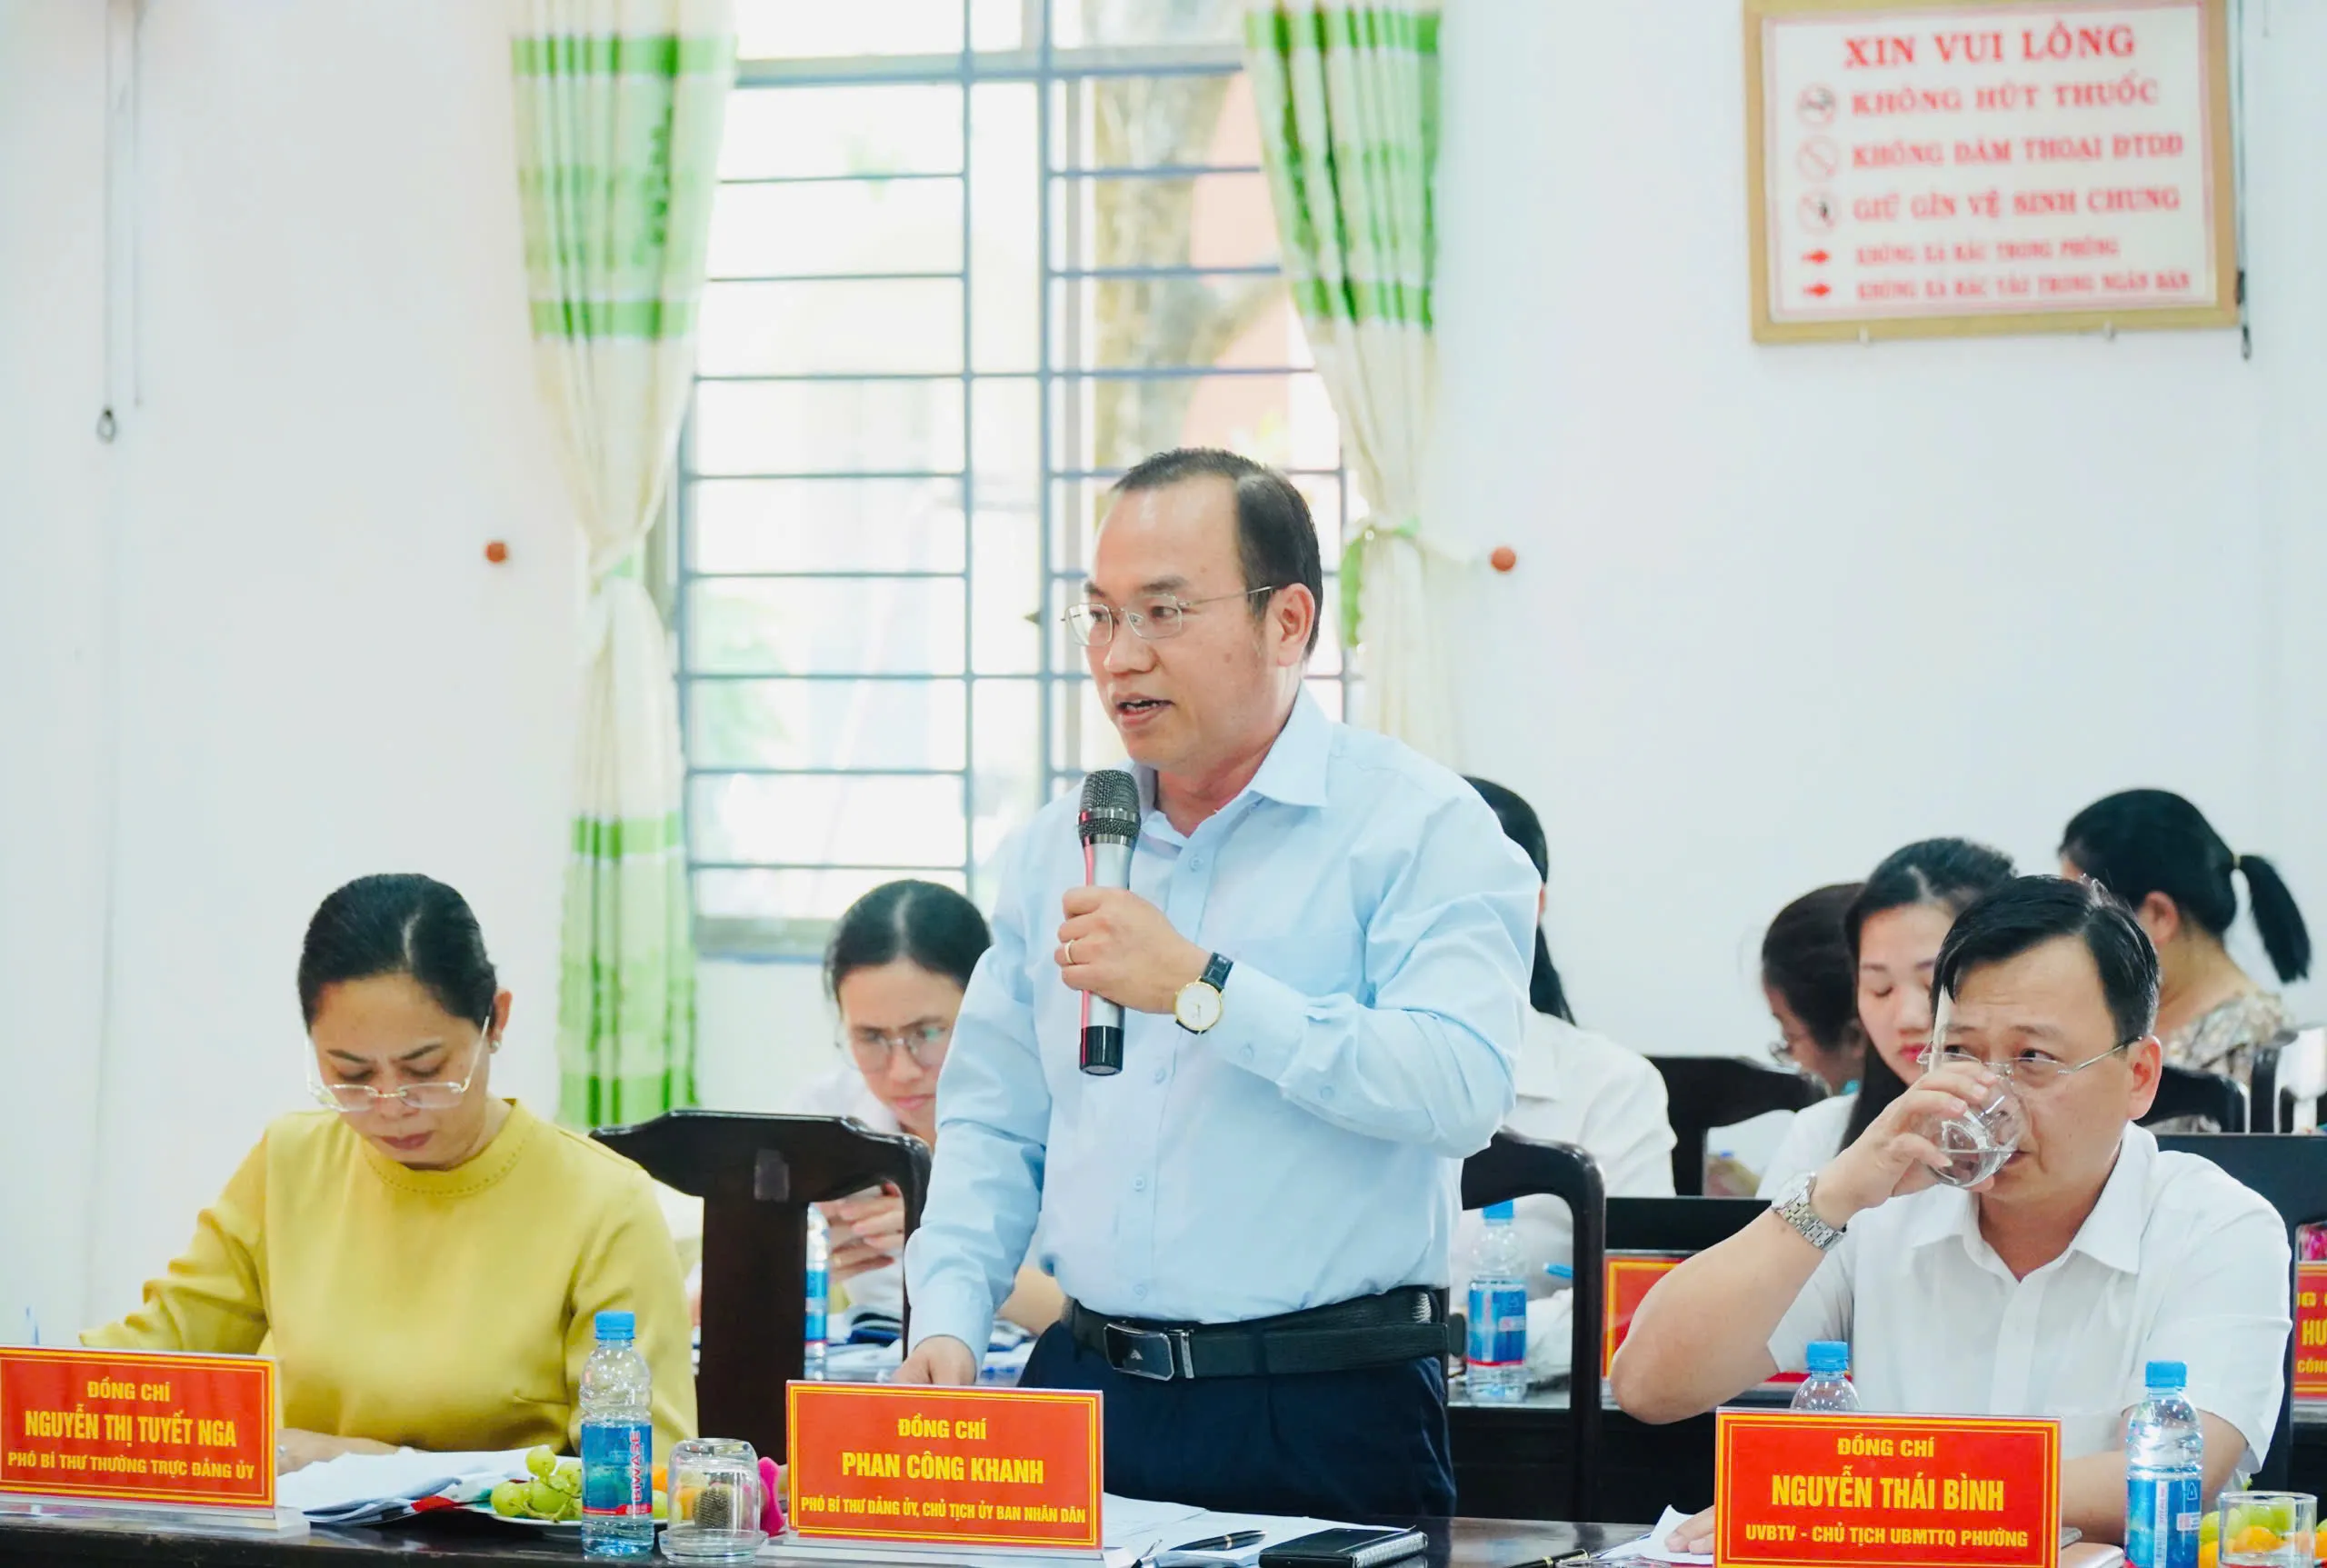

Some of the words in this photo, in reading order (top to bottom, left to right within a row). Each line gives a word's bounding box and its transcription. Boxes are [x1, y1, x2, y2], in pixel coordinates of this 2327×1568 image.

[1843, 34, 1916, 70] XIN
[1933, 28, 2003, 64] VUI
[1853, 85, 1962, 115] KHÔNG
[2053, 69, 2158, 107] THUỐC
[1853, 138, 1944, 168] KHÔNG
[2012, 190, 2077, 216] SINH
[2086, 185, 2181, 214] CHUNG
[87, 1376, 135, 1400] ĐỒNG
[141, 1381, 171, 1402] CHÍ
[25, 1403, 99, 1440] NGUYỄN
[104, 1414, 133, 1447] THỊ
[137, 1409, 193, 1444] TUYẾT
[198, 1419, 237, 1447] NGA
[897, 1413, 950, 1438] ĐỒNG
[955, 1418, 987, 1440] CHÍ
[1837, 1433, 1893, 1456] ĐỒNG
[1901, 1436, 1934, 1458] CHÍ
[8, 1450, 36, 1467] PHÓ
[41, 1451, 55, 1468] BÍ
[58, 1454, 88, 1470] THƯ
[90, 1453, 147, 1473] THƯỜNG
[150, 1459, 188, 1478] TRỰC
[192, 1457, 232, 1479] ĐẢNG
[235, 1459, 255, 1480] ỦY
[630, 1431, 642, 1502] BIWASE
[842, 1452, 900, 1478] PHAN
[907, 1451, 964, 1481] CÔNG
[971, 1457, 1044, 1483] KHANH
[1772, 1464, 1873, 1508] NGUYỄN
[1880, 1472, 1935, 1510] THÁI
[1943, 1473, 2004, 1511] BÌNH
[801, 1494, 824, 1512] PHÓ
[828, 1495, 840, 1513] BÍ
[843, 1497, 865, 1513] THƯ
[868, 1495, 900, 1515] ĐẢNG
[904, 1496, 919, 1518] ỦY,
[923, 1498, 946, 1517] CHỦ
[949, 1503, 975, 1522] TỊCH
[978, 1500, 994, 1519] ỦY
[996, 1505, 1021, 1521] BAN
[1024, 1504, 1057, 1523] NHÂN
[1061, 1505, 1086, 1523] DÂN
[1745, 1523, 1796, 1542] UVBTV
[1812, 1521, 1845, 1543] CHỦ
[1849, 1526, 1886, 1547] TỊCH
[1890, 1527, 1956, 1547] UBMTTQ
[1961, 1526, 2029, 1547] PHƯỜNG
